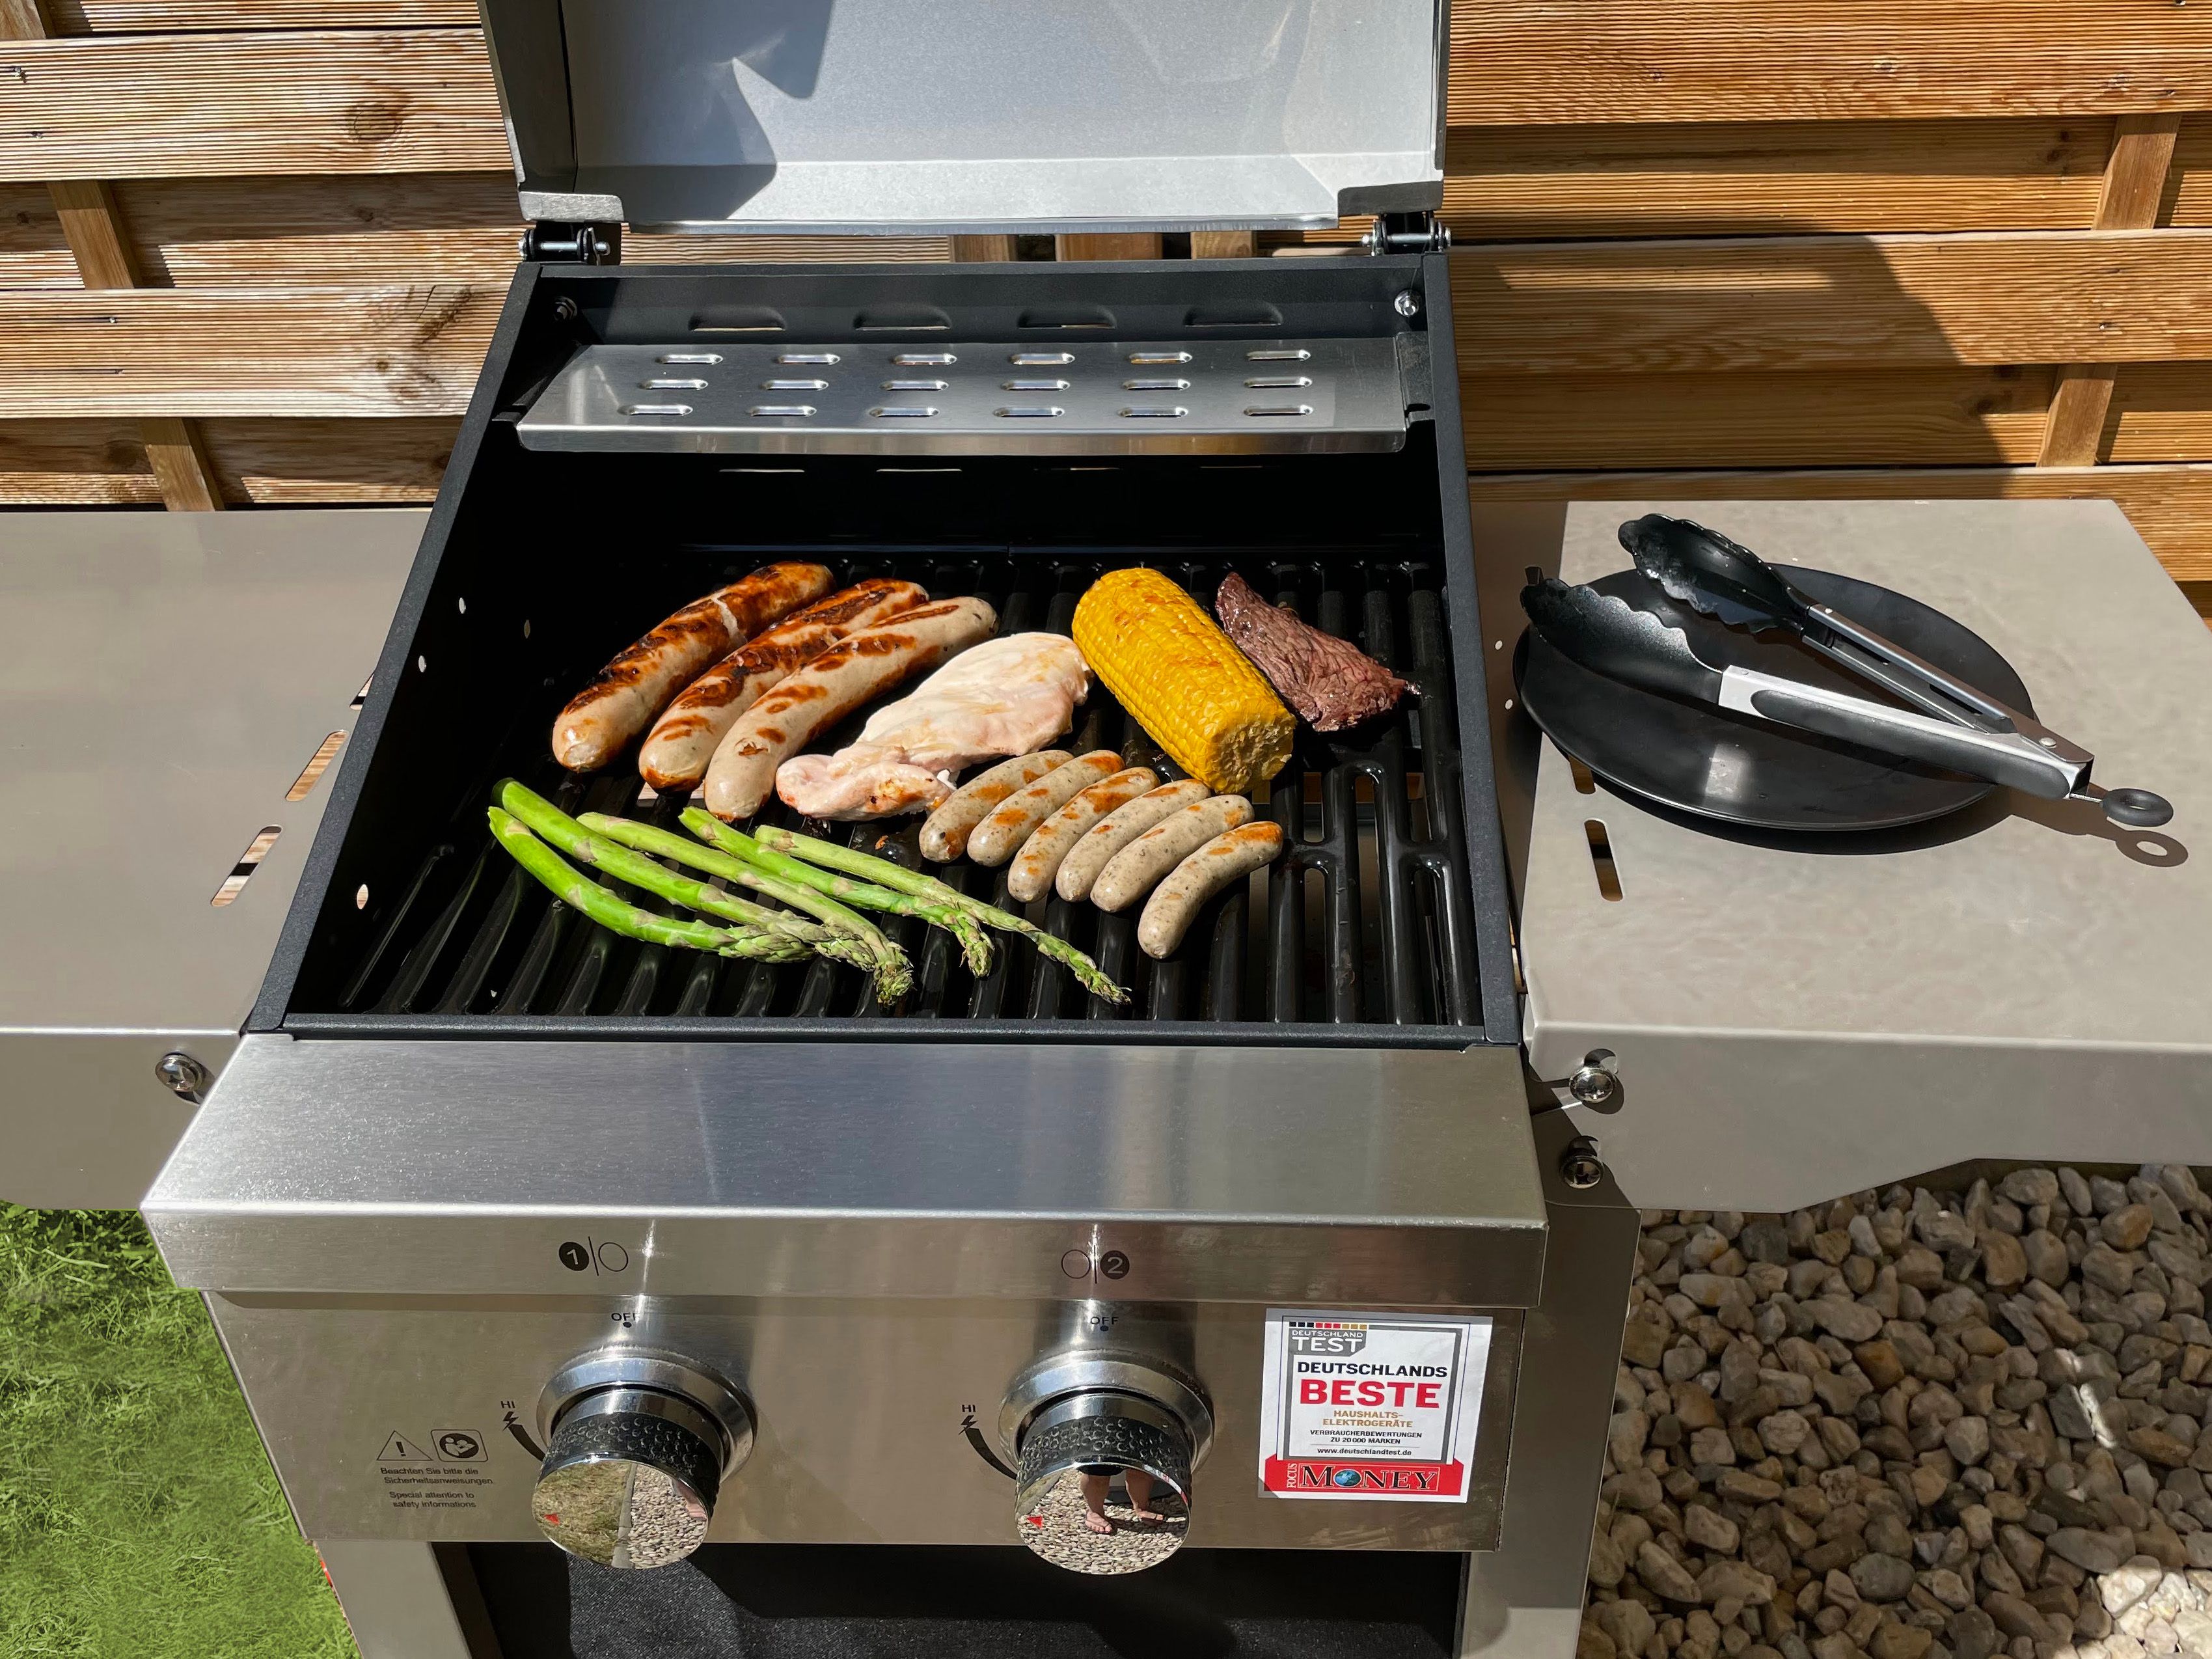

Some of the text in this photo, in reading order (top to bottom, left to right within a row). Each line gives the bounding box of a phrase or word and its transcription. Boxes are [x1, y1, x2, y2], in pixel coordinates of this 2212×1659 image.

[1107, 1256, 1124, 1274] 2
[610, 1312, 641, 1321] OFF
[1089, 1316, 1119, 1325] OFF
[1291, 1330, 1363, 1338] DEUTSCHLAND
[1291, 1336, 1363, 1353] TEST
[1297, 1361, 1448, 1378] DEUTSCHLANDS
[1300, 1378, 1443, 1408] BESTE
[500, 1400, 515, 1409] HI
[961, 1404, 976, 1413] HI
[1333, 1410, 1404, 1419] HAUSHALTS-
[1322, 1418, 1413, 1428] ELEKTROGERÄTE
[1310, 1429, 1423, 1438] VERBRAUCHERBEWERTUNGEN
[1317, 1447, 1412, 1457] www.deutschlandtest.de
[1286, 1462, 1298, 1488] FOCUS
[384, 1477, 493, 1486] Sicherheitsanweisungen
[389, 1491, 422, 1500] Special
[392, 1500, 420, 1509] safety
